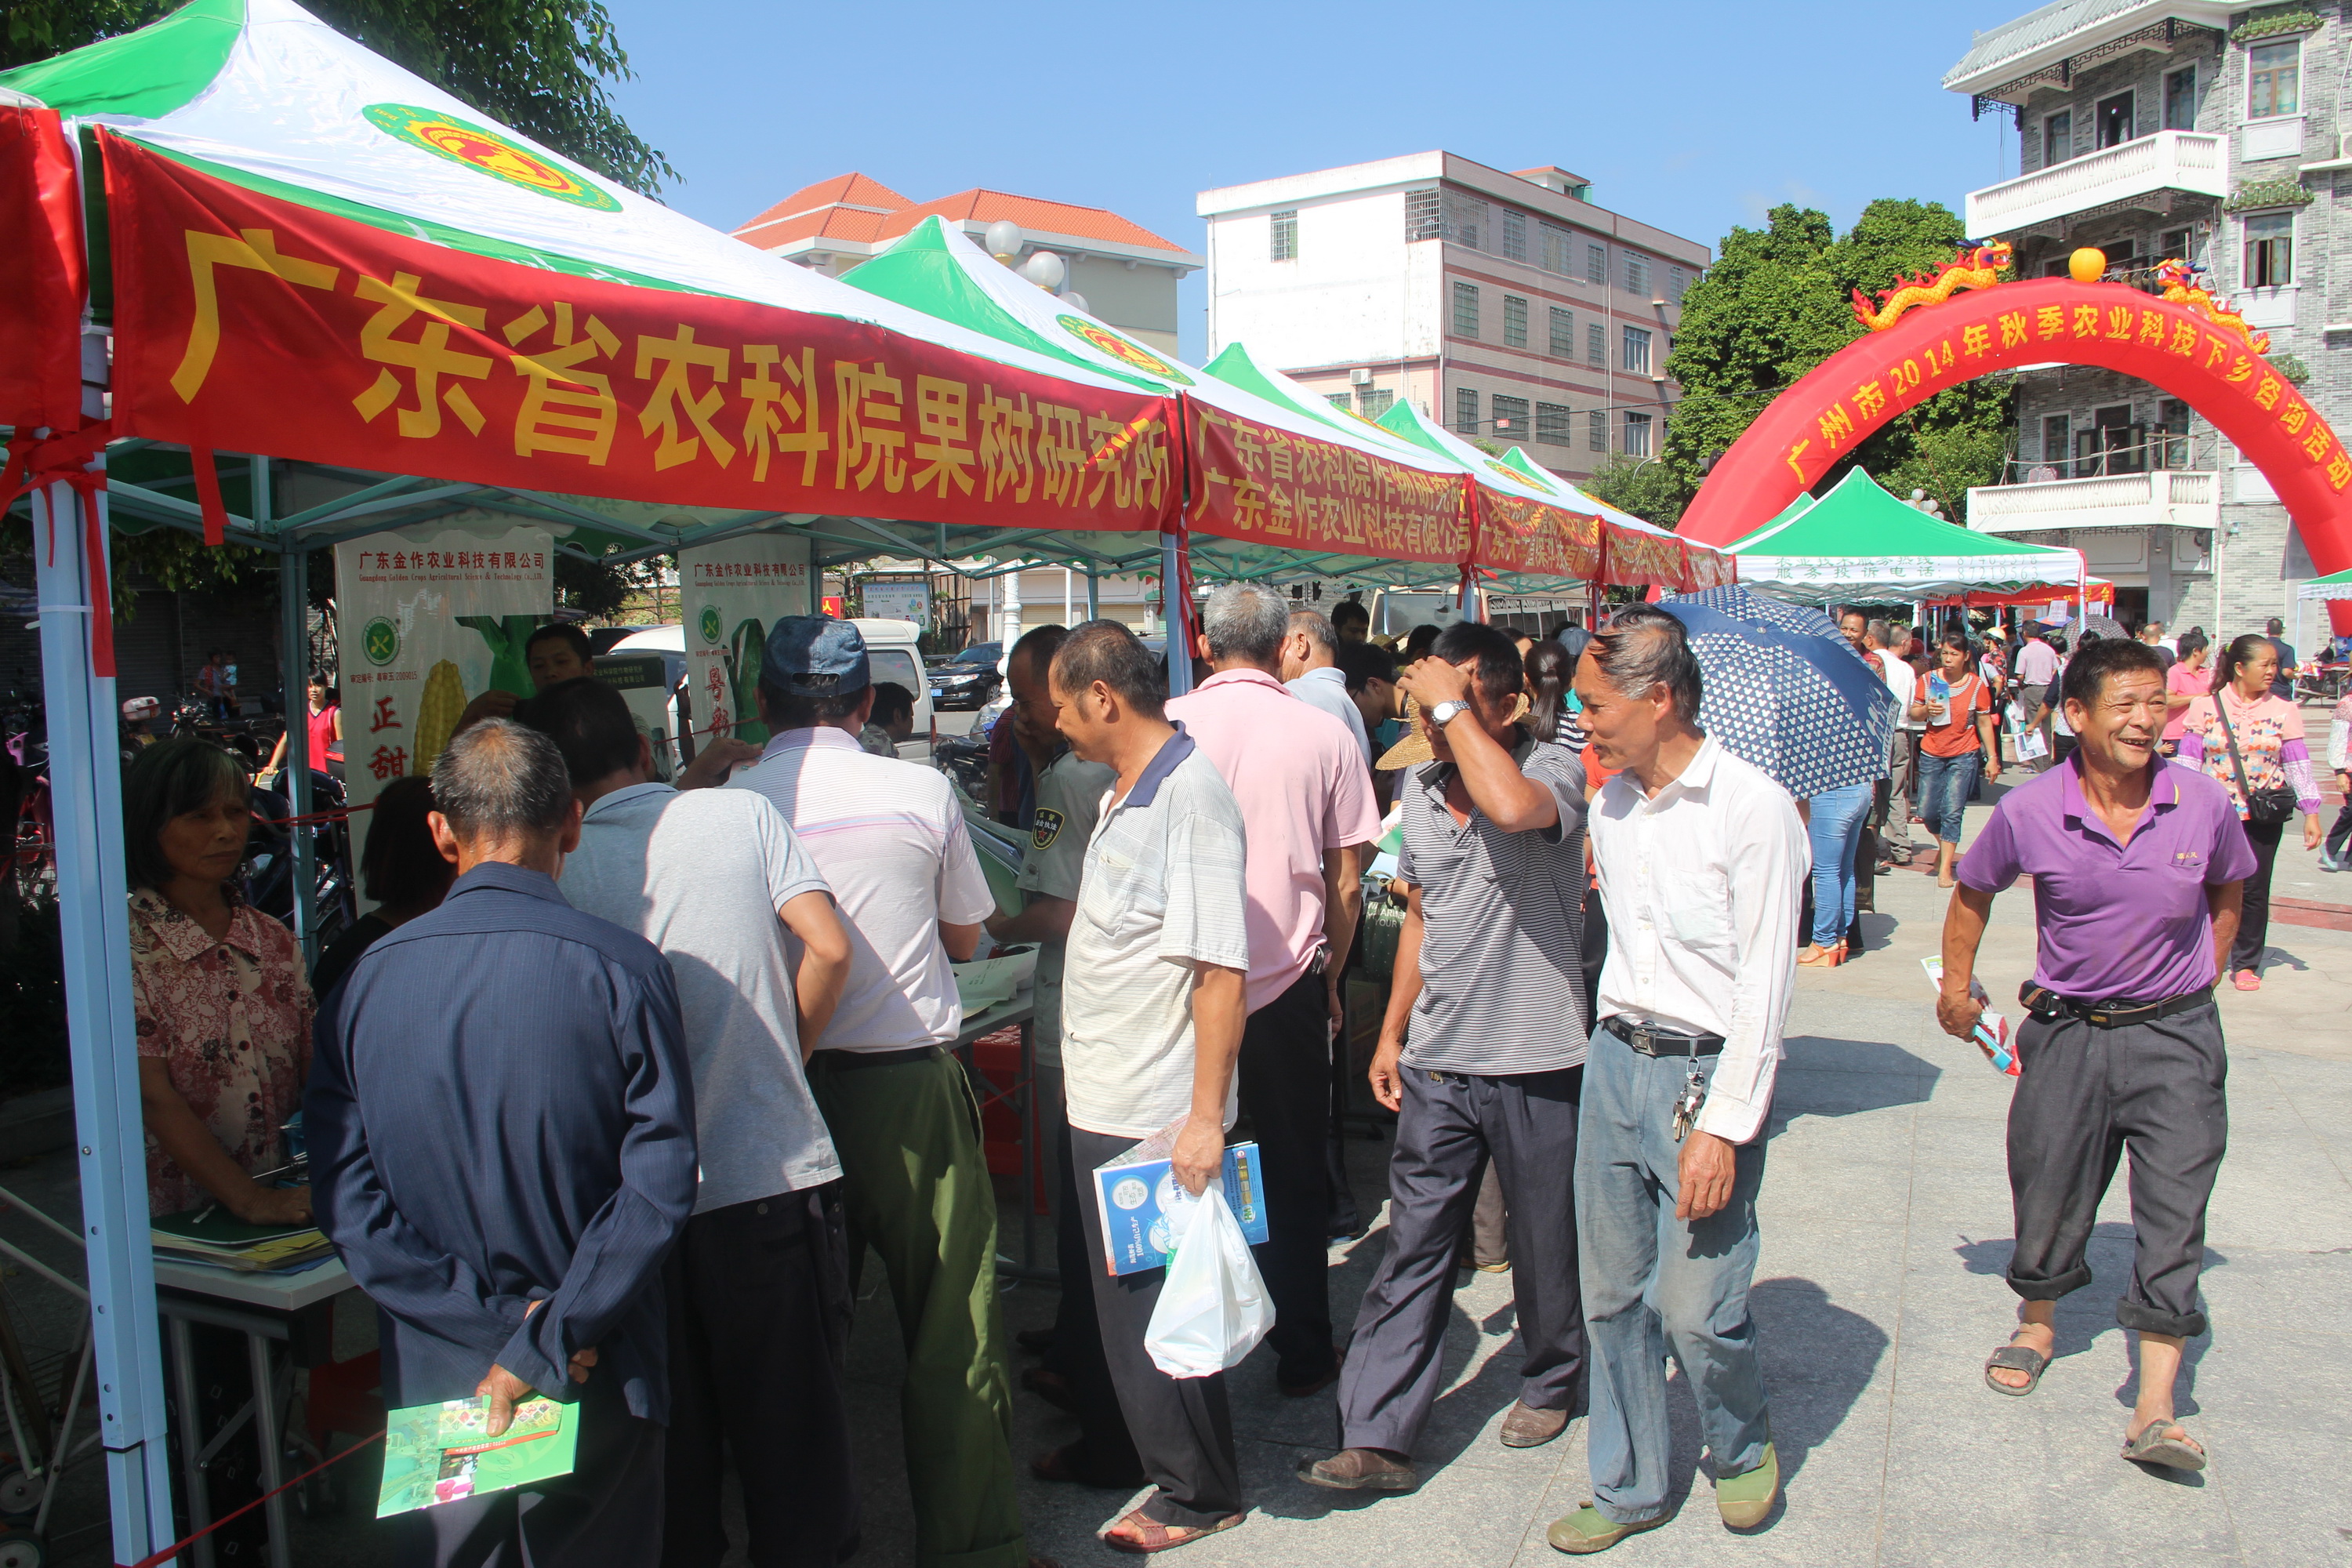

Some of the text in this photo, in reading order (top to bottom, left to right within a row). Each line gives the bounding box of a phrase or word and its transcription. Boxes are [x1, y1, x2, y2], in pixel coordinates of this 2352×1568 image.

[170, 229, 1166, 511] 广东省农科院果树研究所
[1784, 303, 2352, 497] 广州市2014年秋季农业科技下乡咨询活动
[1198, 408, 1468, 515] 广东省农科院作物研究所
[1194, 467, 1472, 556] 广东金作农业科技有限公司
[359, 551, 544, 569] 广东金作农业科技有限公司
[359, 574, 387, 583] Guangdong
[412, 573, 426, 582] Crops
[429, 573, 462, 582] Agricultural
[494, 573, 521, 582] Technology
[694, 563, 805, 577] 广东金作农业科技有限公司
[1775, 566, 2038, 580] 服务投诉电话： 87219563
[368, 695, 408, 780] 正甜
